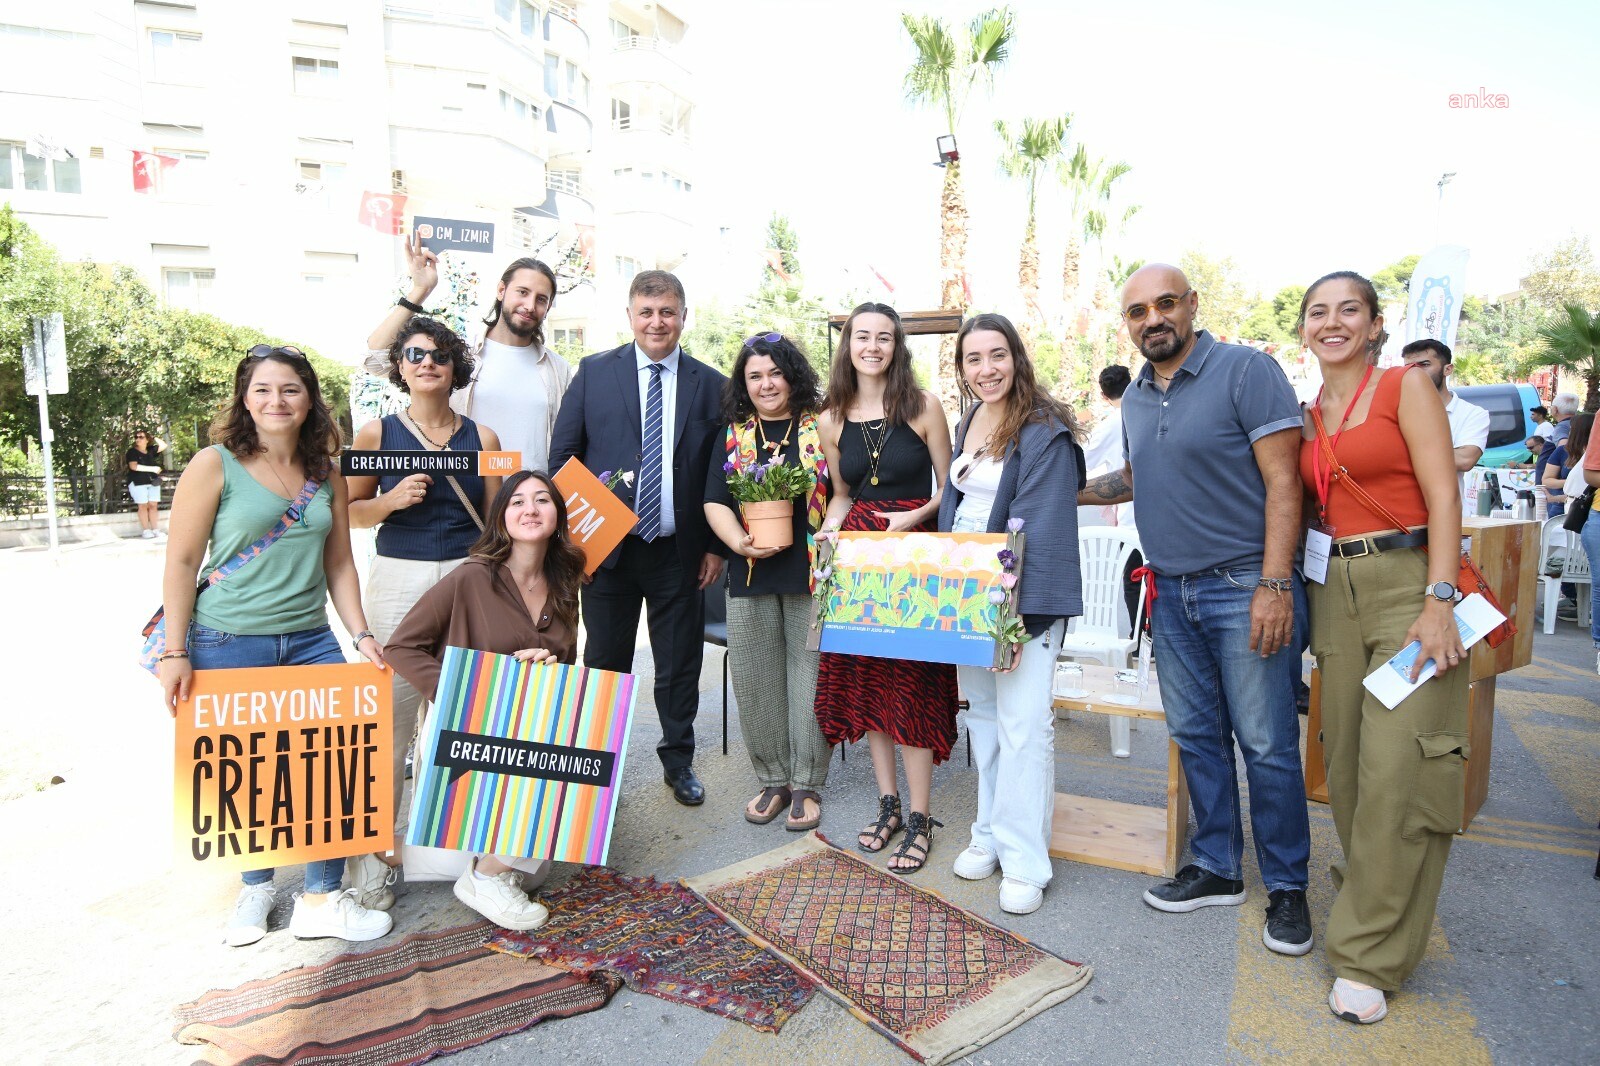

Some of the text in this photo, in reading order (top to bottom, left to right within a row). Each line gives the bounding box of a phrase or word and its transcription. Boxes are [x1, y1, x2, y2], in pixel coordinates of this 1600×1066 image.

[436, 226, 490, 244] CM_IZMIR
[488, 457, 513, 470] IZMIR
[194, 684, 378, 728] EVERYONE IS
[192, 745, 378, 836] CREATIVE
